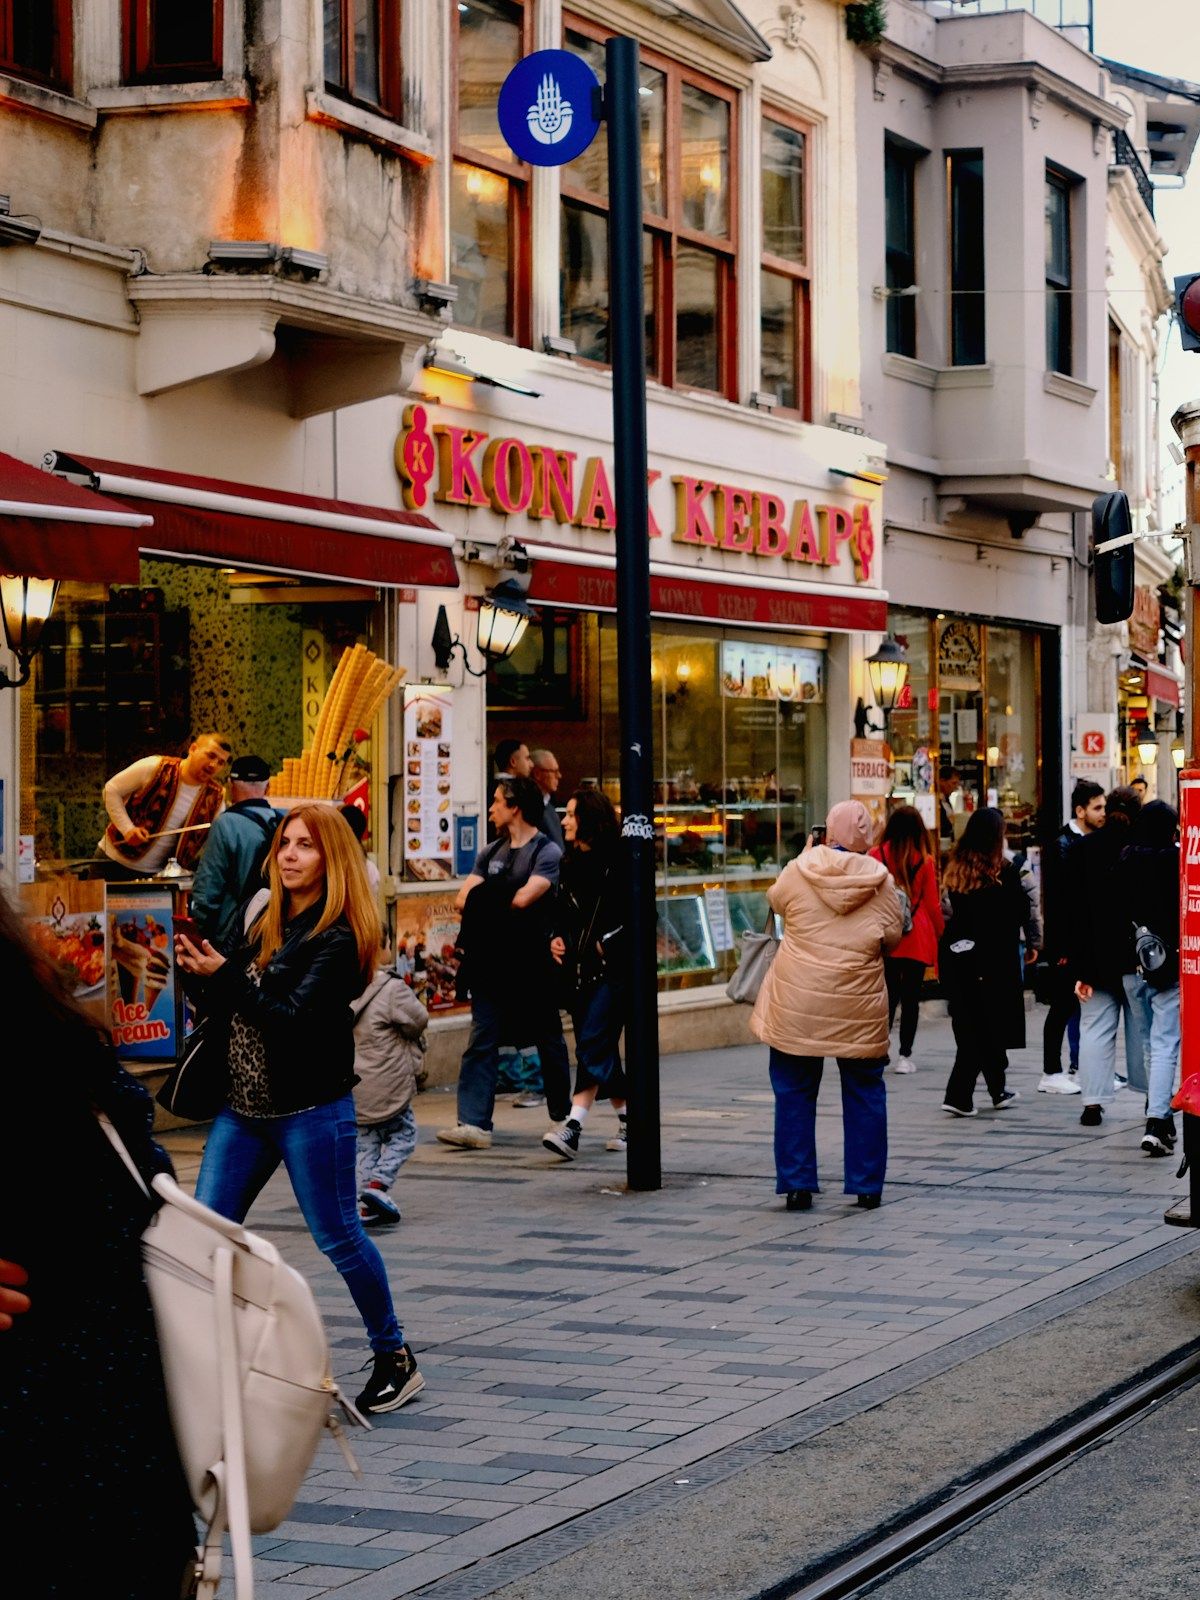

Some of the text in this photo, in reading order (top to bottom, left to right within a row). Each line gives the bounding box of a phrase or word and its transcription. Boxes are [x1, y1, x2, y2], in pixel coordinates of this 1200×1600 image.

[433, 424, 852, 568] KONA KEBAP
[1086, 735, 1101, 752] K
[852, 762, 885, 778] TERRACE
[113, 999, 148, 1023] Ice
[112, 1021, 169, 1046] ream
